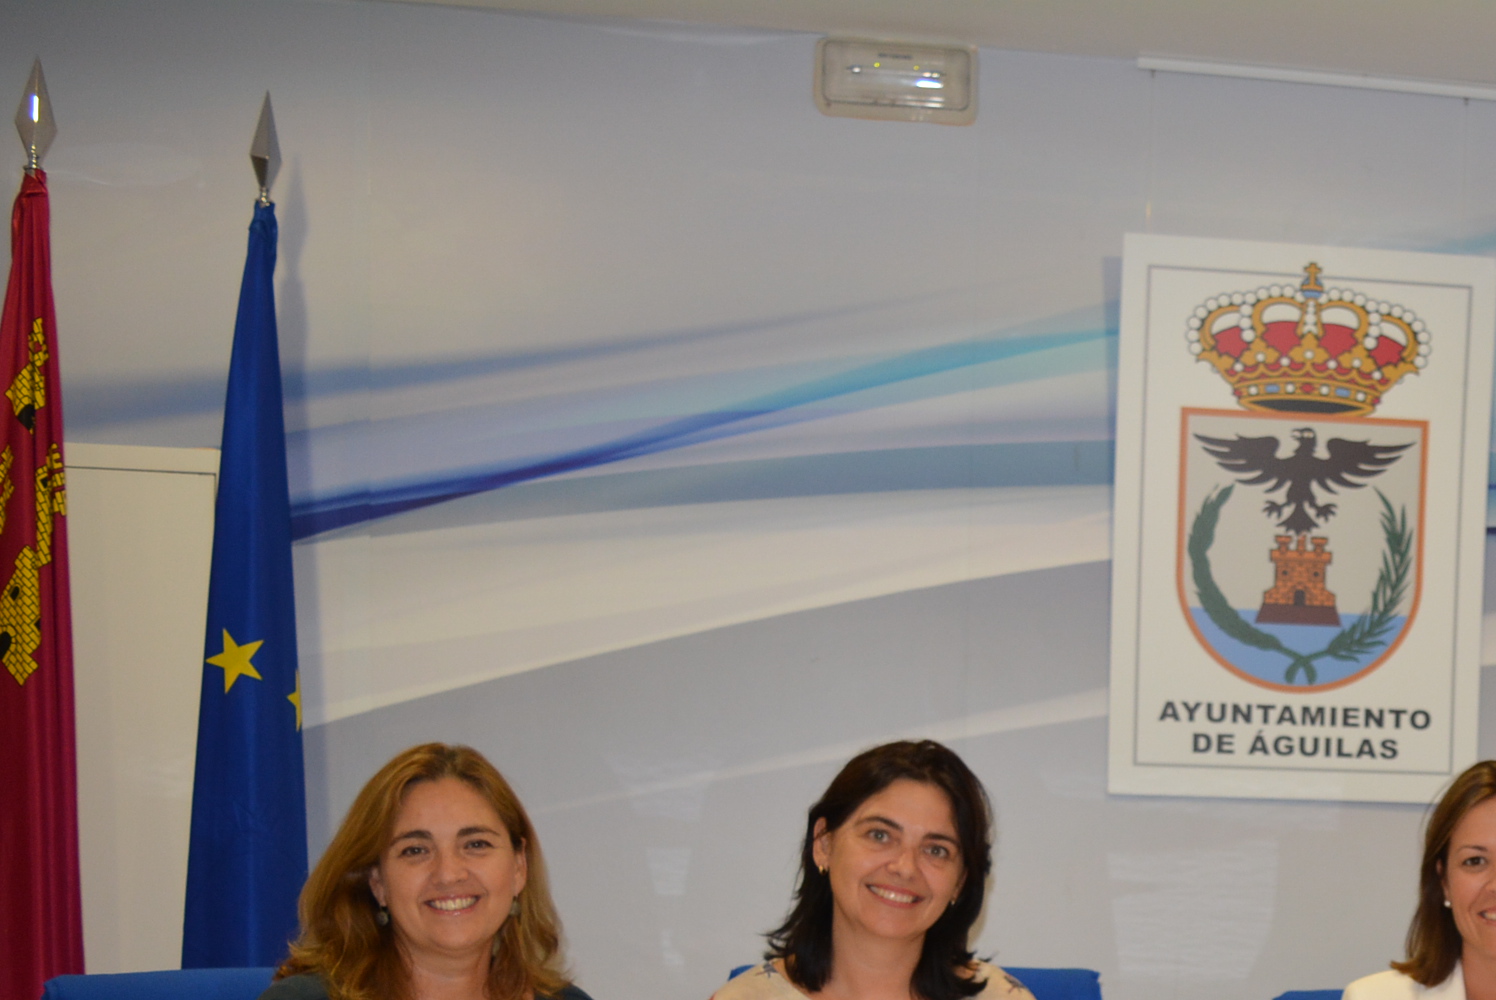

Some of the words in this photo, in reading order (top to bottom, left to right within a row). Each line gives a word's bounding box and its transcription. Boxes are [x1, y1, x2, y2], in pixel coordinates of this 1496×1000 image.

[1158, 700, 1432, 732] AYUNTAMIENTO
[1191, 732, 1236, 756] DE
[1248, 730, 1399, 760] ÁGUILAS
